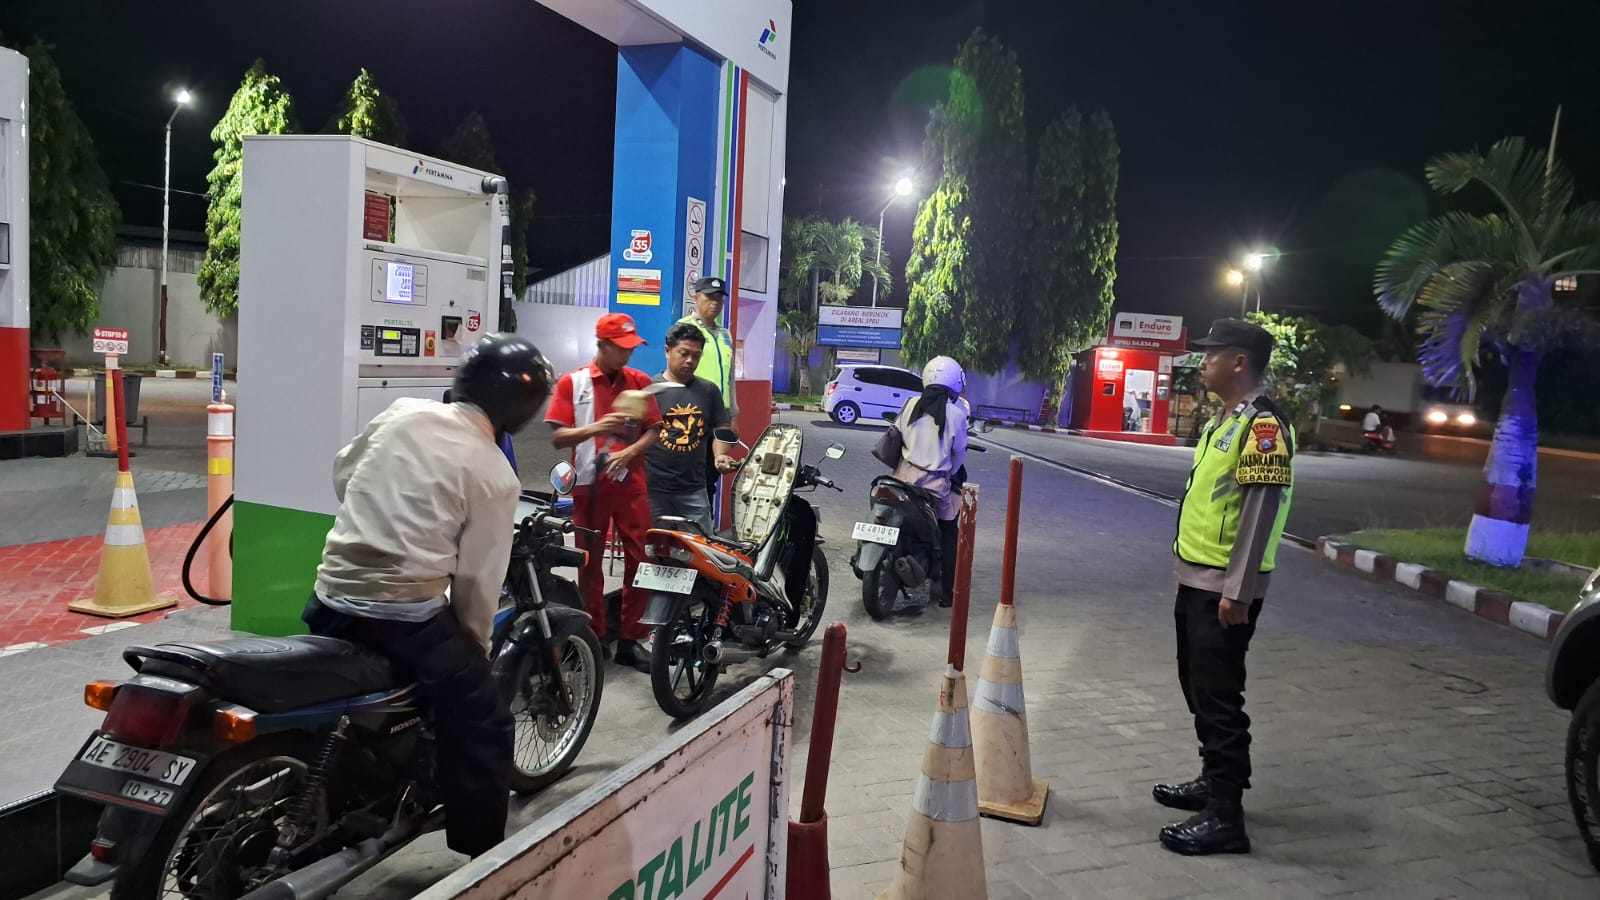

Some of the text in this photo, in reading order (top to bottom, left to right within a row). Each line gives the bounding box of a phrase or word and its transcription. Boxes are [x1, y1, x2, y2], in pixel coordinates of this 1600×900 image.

[425, 169, 453, 181] PERTAMINA
[1139, 321, 1172, 331] Enduro
[868, 525, 886, 535] 4810
[655, 566, 681, 579] 3754
[682, 570, 696, 582] SU
[390, 716, 421, 734] HONDA
[86, 740, 189, 782] AE 2904 SY
[125, 782, 170, 805] 10 27
